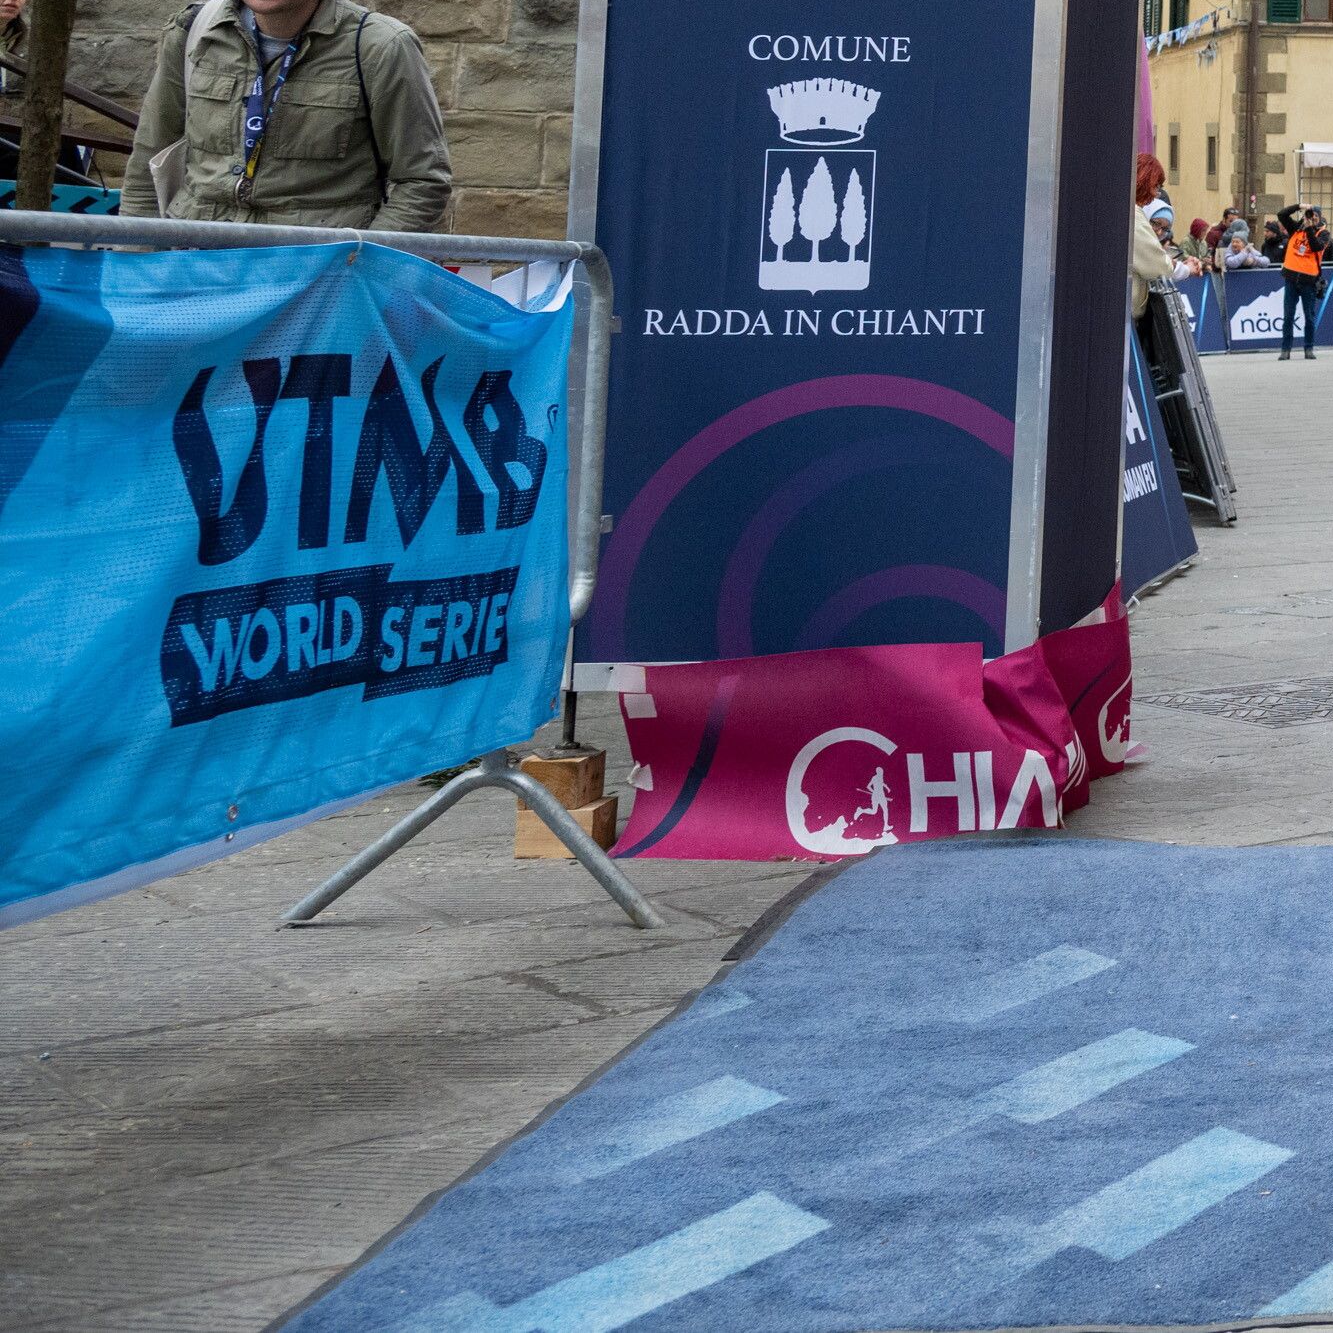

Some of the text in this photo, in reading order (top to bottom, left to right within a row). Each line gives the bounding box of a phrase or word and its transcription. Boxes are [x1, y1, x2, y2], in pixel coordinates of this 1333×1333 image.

[748, 34, 911, 63] COMUNE
[643, 308, 985, 337] RADDA IN CHIANTI
[178, 592, 510, 693] WORLD SERIE
